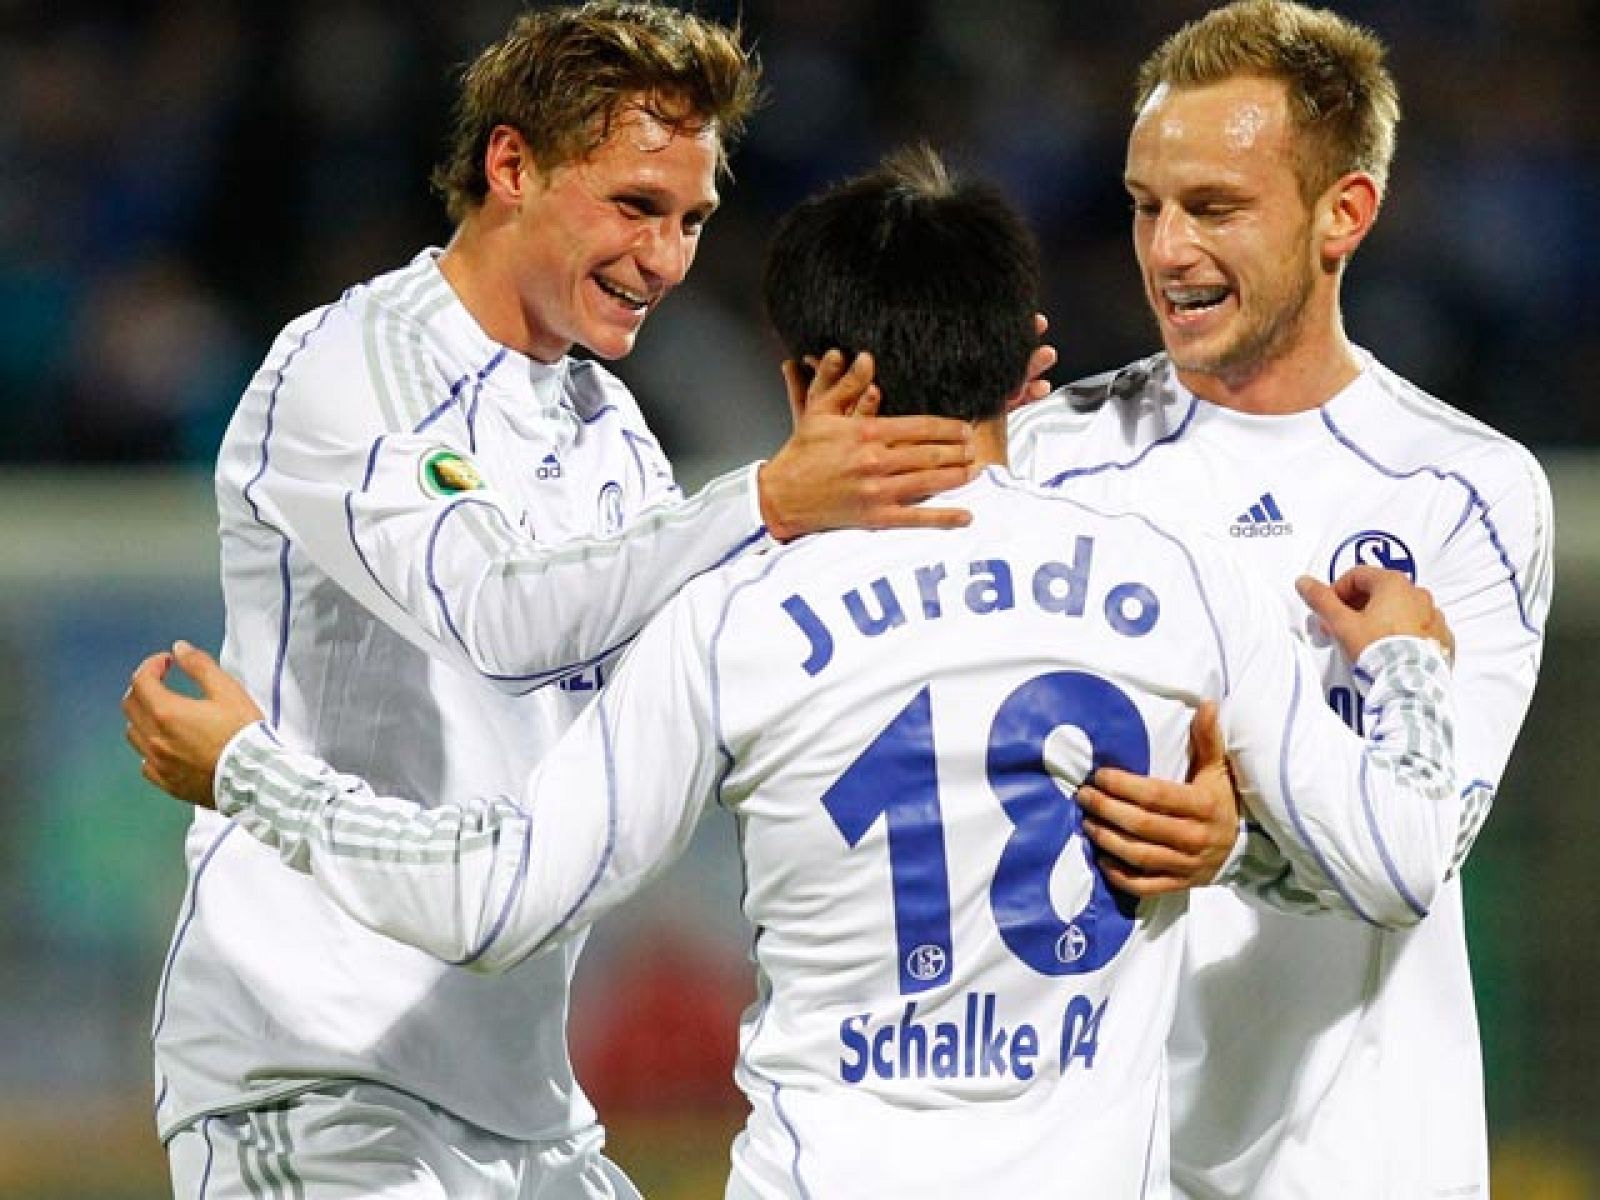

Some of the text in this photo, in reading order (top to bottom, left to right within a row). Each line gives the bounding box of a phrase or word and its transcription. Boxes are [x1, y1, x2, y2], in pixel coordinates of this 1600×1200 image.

[1230, 522, 1293, 538] adidas
[781, 535, 1160, 677] Jurado
[820, 671, 1151, 995] 18
[840, 991, 1039, 1084] Schalke
